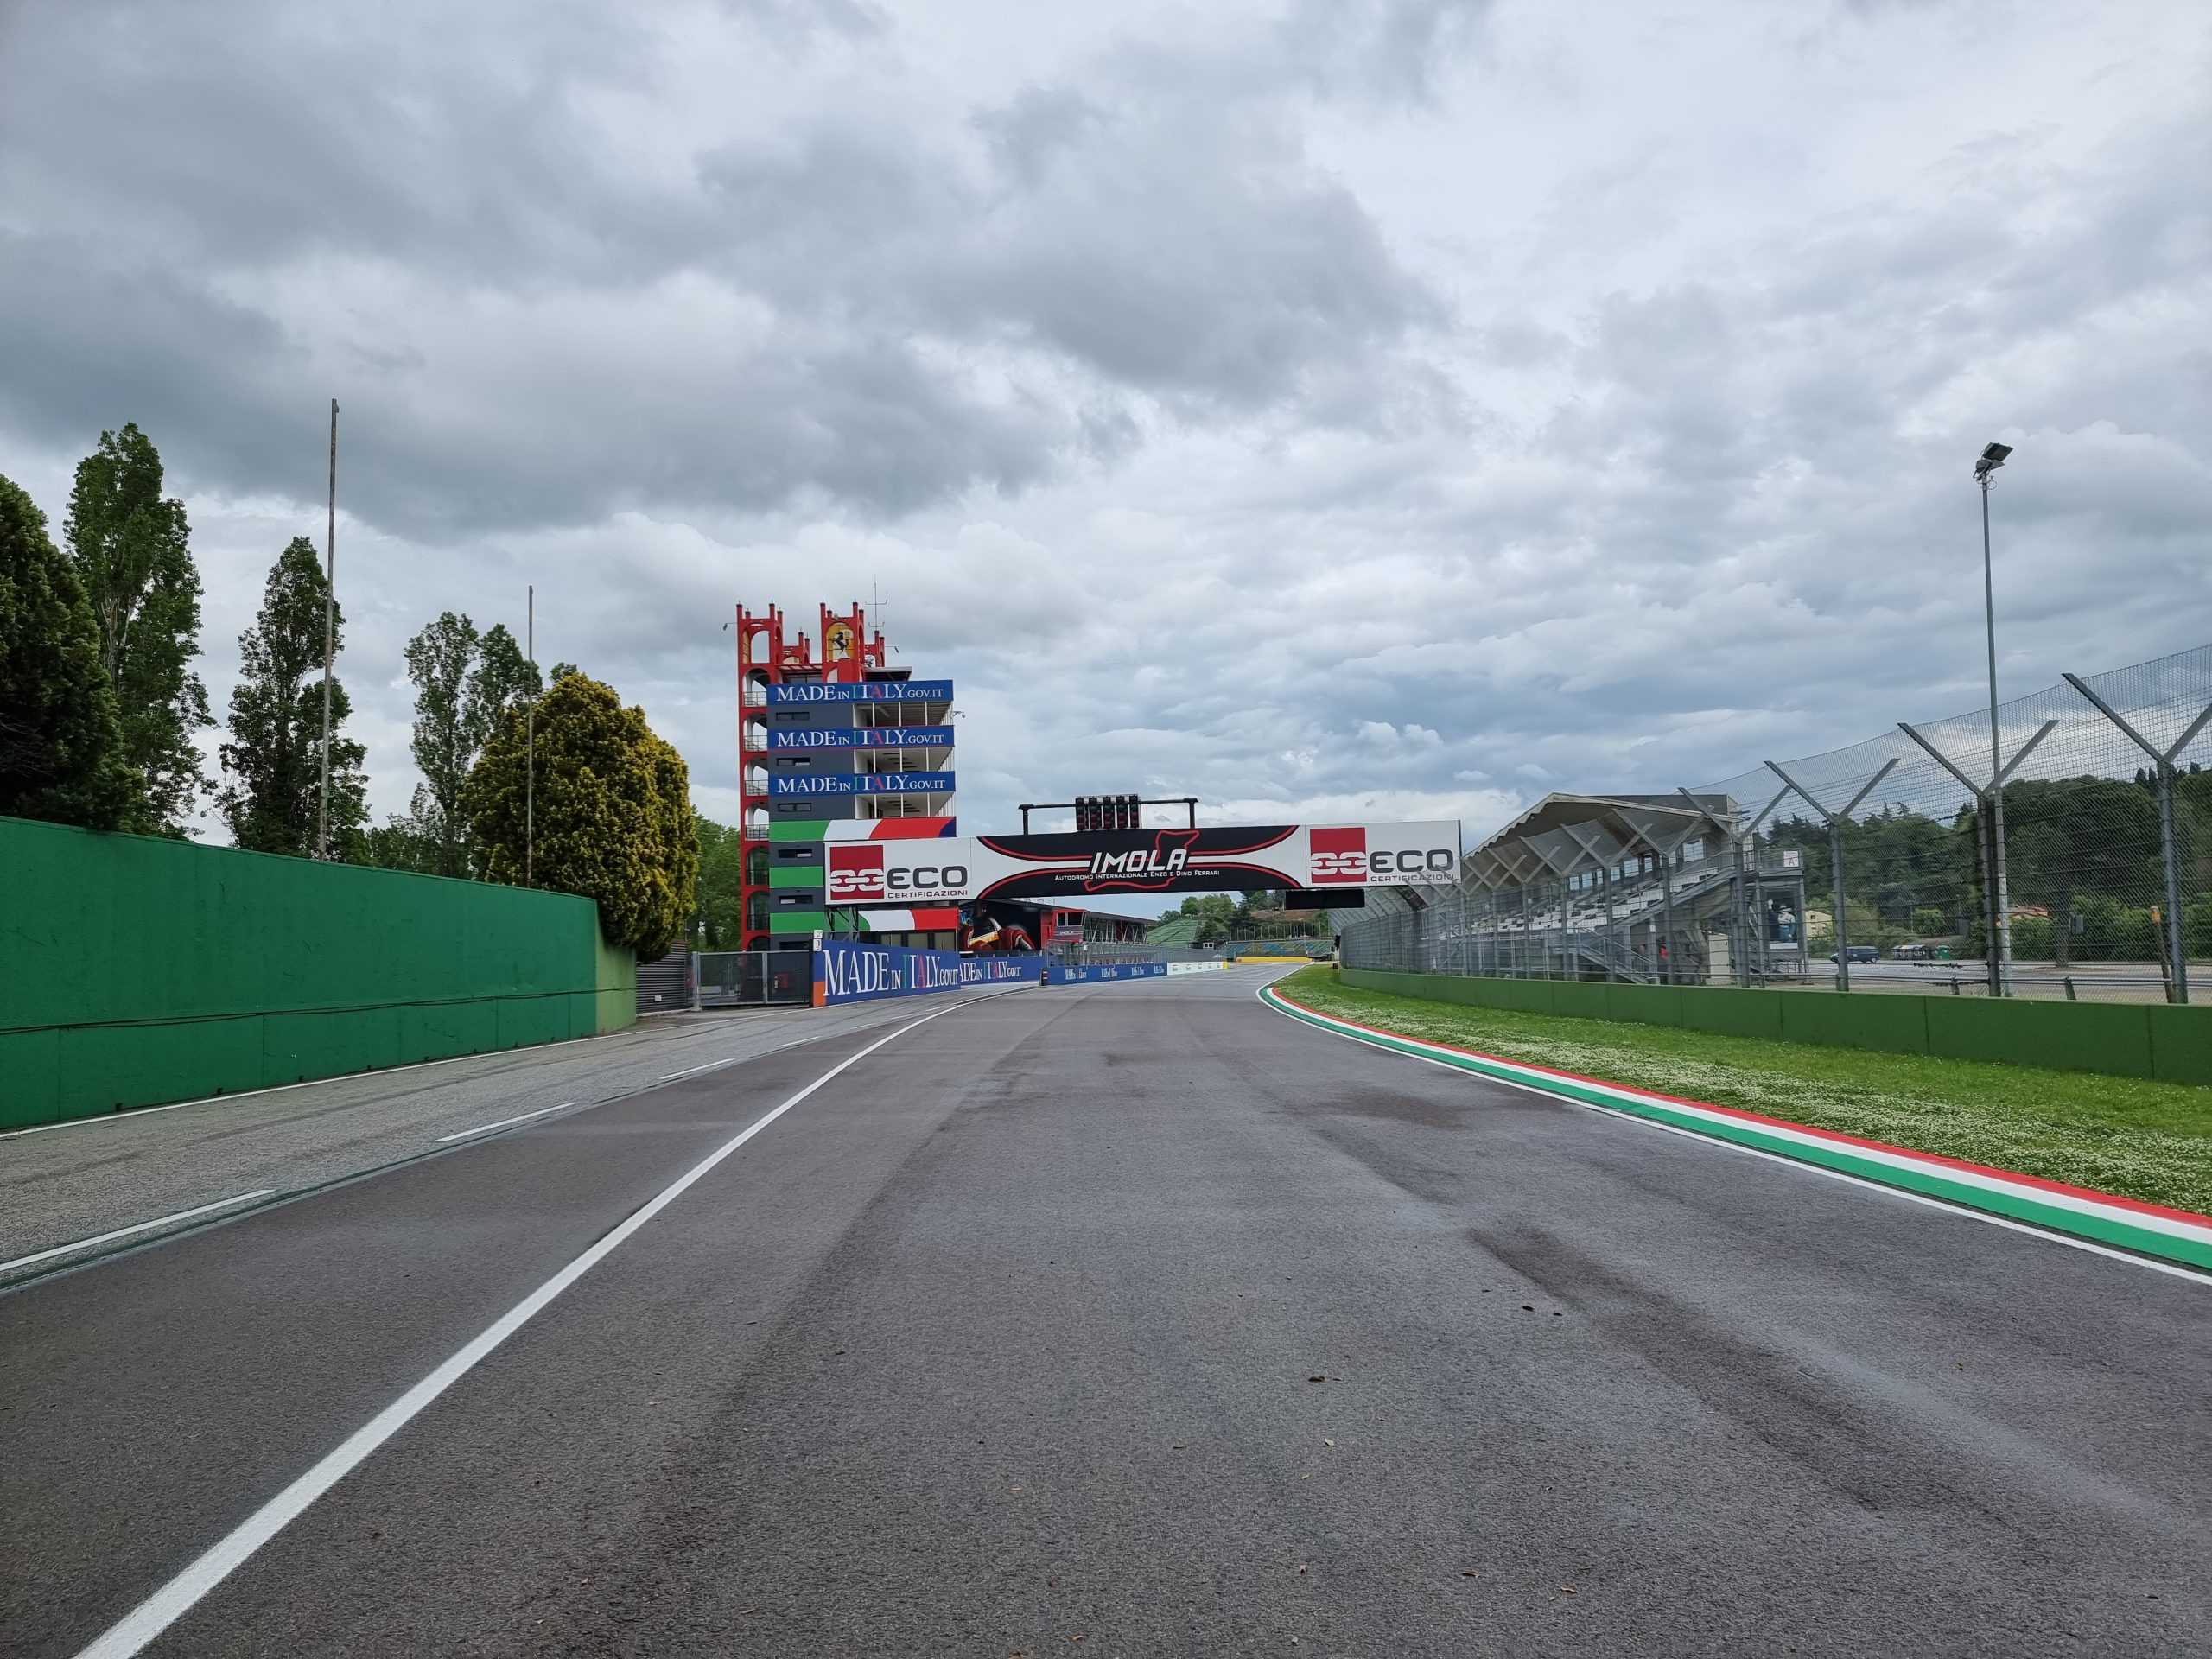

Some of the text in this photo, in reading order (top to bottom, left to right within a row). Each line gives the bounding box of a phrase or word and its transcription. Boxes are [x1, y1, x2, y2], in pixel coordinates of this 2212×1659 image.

[777, 685, 836, 701] MADE
[838, 690, 849, 699] IN
[778, 731, 836, 747] MADE
[839, 736, 850, 745] IN
[778, 777, 837, 793] MADE
[839, 782, 851, 791] IN
[1091, 849, 1187, 874] IMOLA
[1370, 849, 1454, 873] ECO
[887, 866, 968, 889] ECO
[887, 890, 968, 899] CERTIFICAZIONI
[823, 950, 889, 996] MADE
[891, 969, 902, 990] IN
[960, 962, 976, 982] ADE
